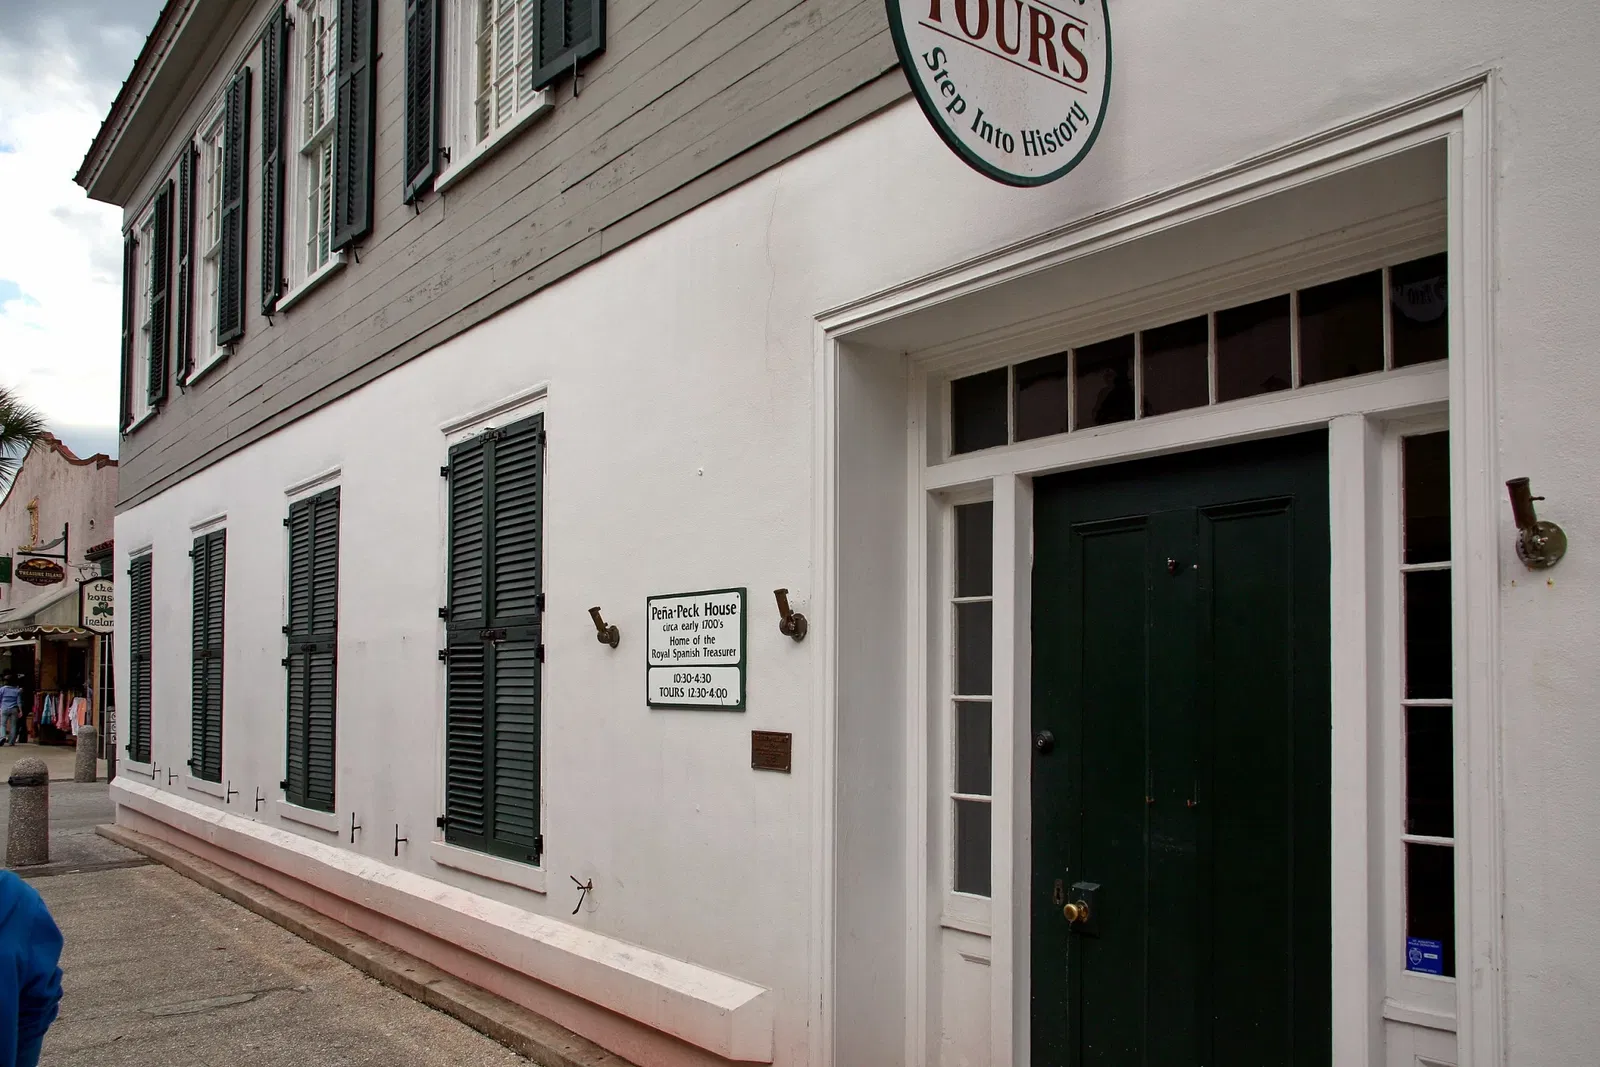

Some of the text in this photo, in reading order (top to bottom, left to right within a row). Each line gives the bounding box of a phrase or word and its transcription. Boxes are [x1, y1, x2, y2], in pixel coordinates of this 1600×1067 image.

[922, 46, 1090, 157] Step Into History
[94, 583, 114, 592] the
[87, 592, 114, 602] hous
[704, 602, 737, 616] House
[662, 619, 724, 632] circa early 1700's
[669, 635, 716, 646] Home of the
[651, 647, 737, 661] Royal Spanish Treasurer
[673, 673, 712, 684] 10:30-4:30
[659, 687, 728, 699] TOURS 12:30-4:00
